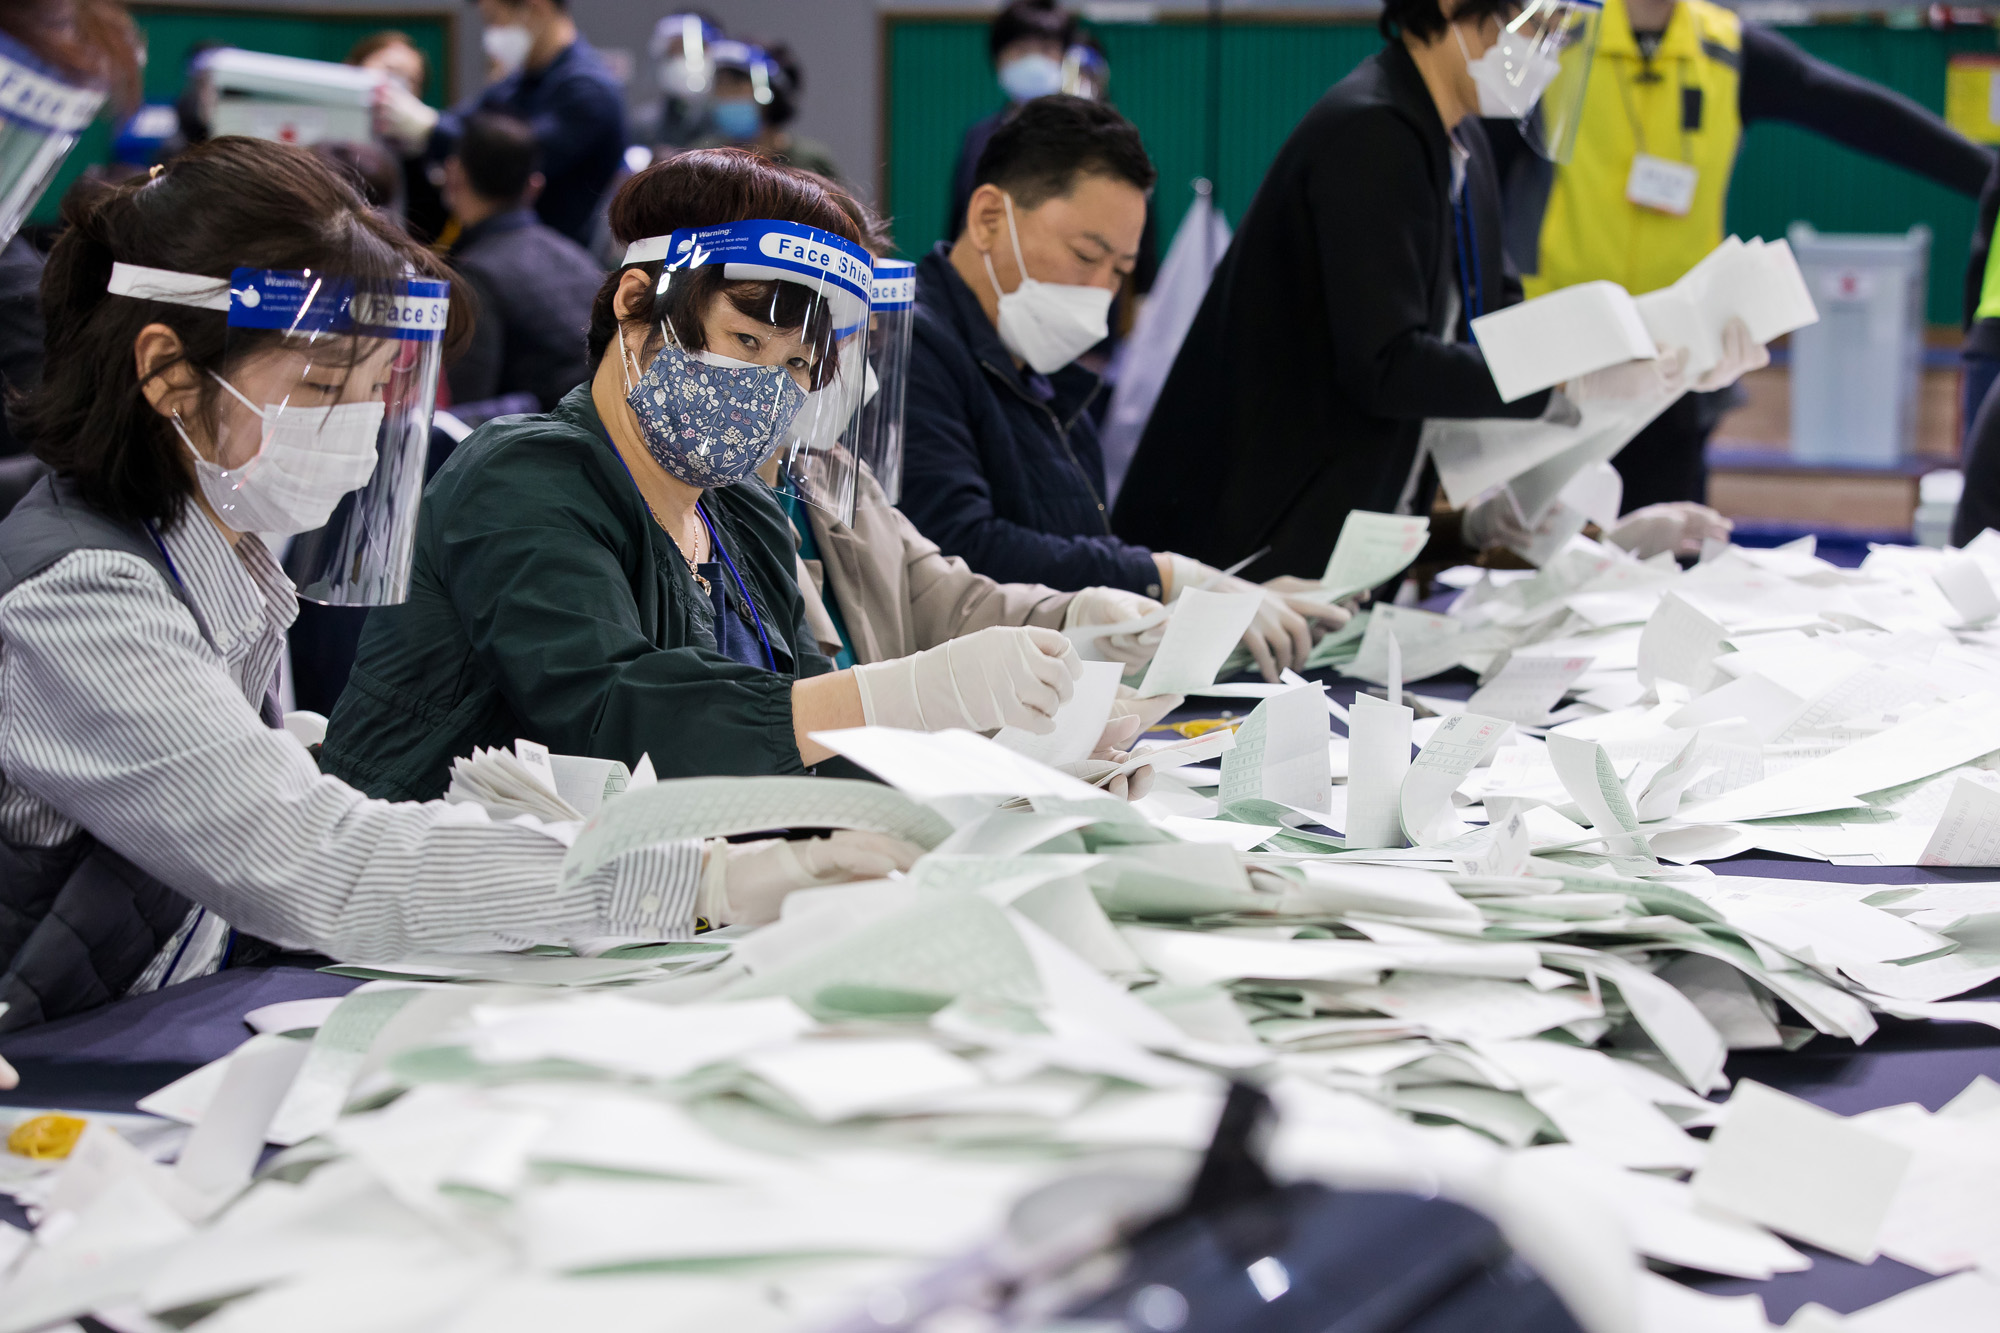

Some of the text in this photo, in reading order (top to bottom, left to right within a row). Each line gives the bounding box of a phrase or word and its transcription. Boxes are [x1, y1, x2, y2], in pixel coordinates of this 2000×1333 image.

[698, 228, 732, 239] Warning:
[778, 238, 830, 267] Face
[872, 287, 897, 299] ace
[371, 299, 424, 323] Face
